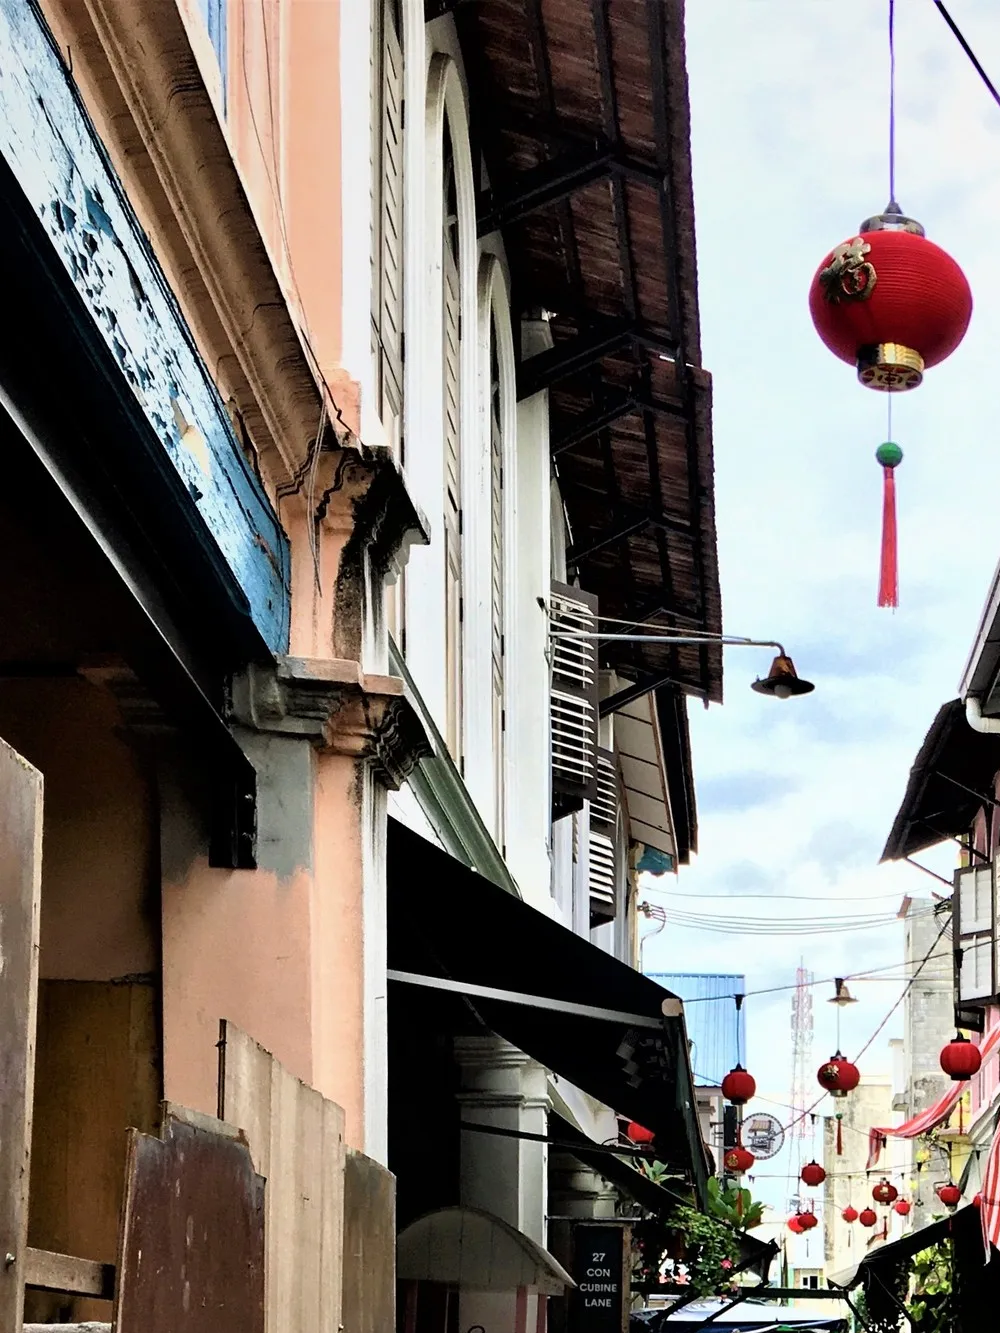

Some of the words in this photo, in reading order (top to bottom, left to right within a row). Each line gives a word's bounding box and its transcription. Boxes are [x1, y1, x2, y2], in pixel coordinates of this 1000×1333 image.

[592, 1252, 606, 1262] 27
[586, 1268, 611, 1277] CON
[580, 1283, 617, 1292] CUBINE
[584, 1298, 612, 1307] LANE
